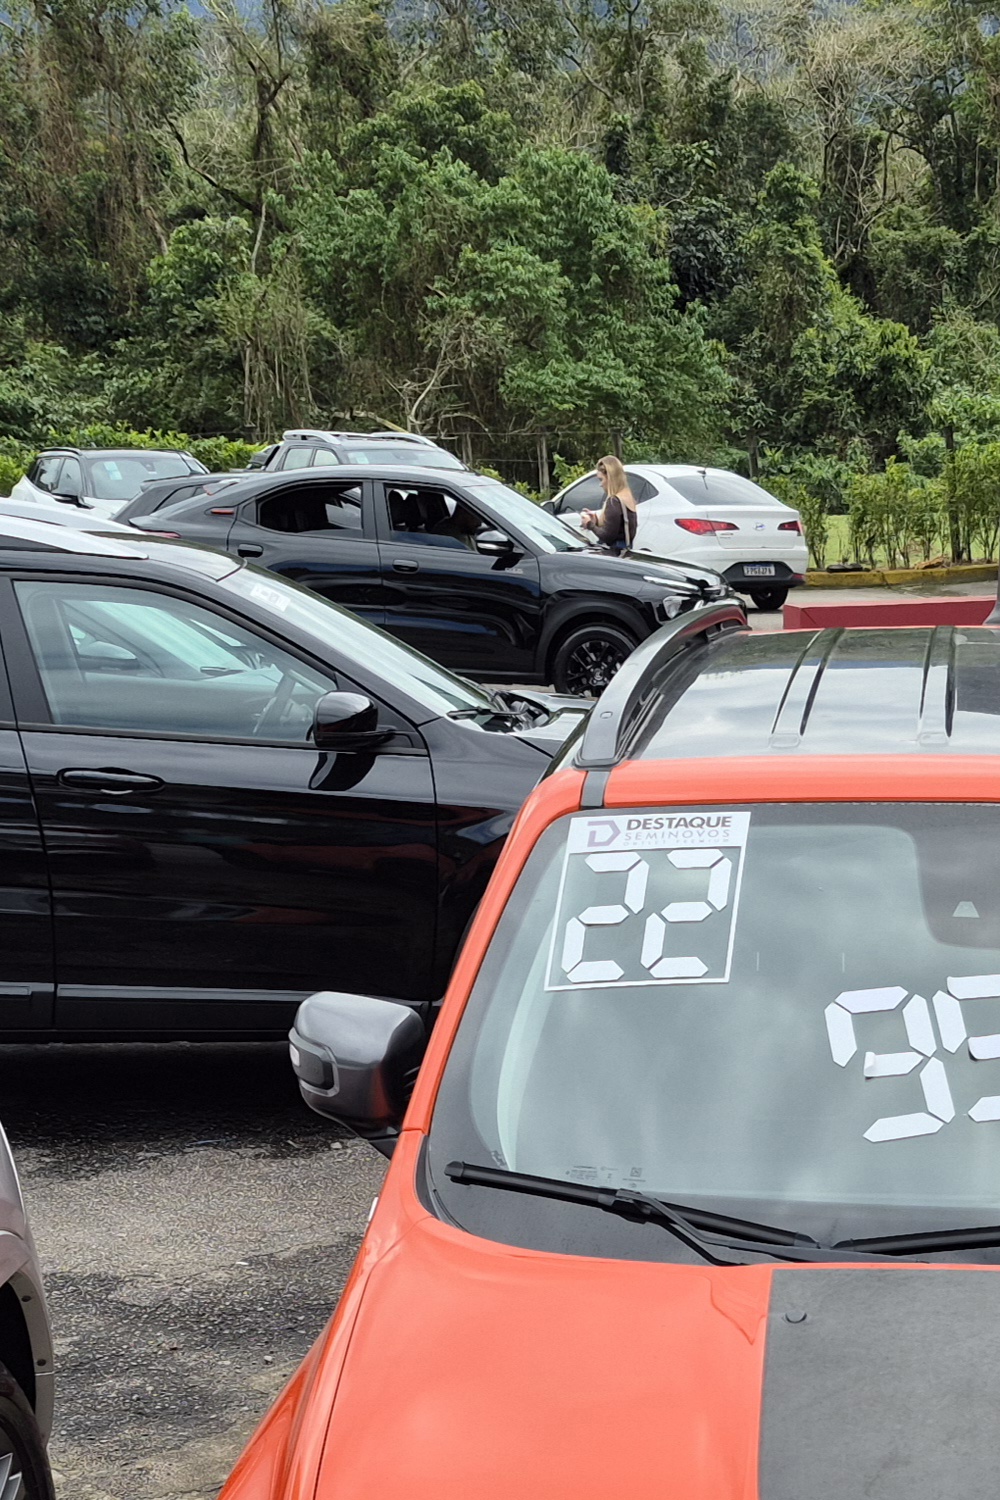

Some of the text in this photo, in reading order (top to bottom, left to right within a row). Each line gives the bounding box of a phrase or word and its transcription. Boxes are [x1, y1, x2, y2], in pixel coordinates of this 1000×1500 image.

[626, 816, 732, 831] DESTAQUE
[624, 829, 731, 841] SEMINOVOS
[561, 848, 733, 984] 22
